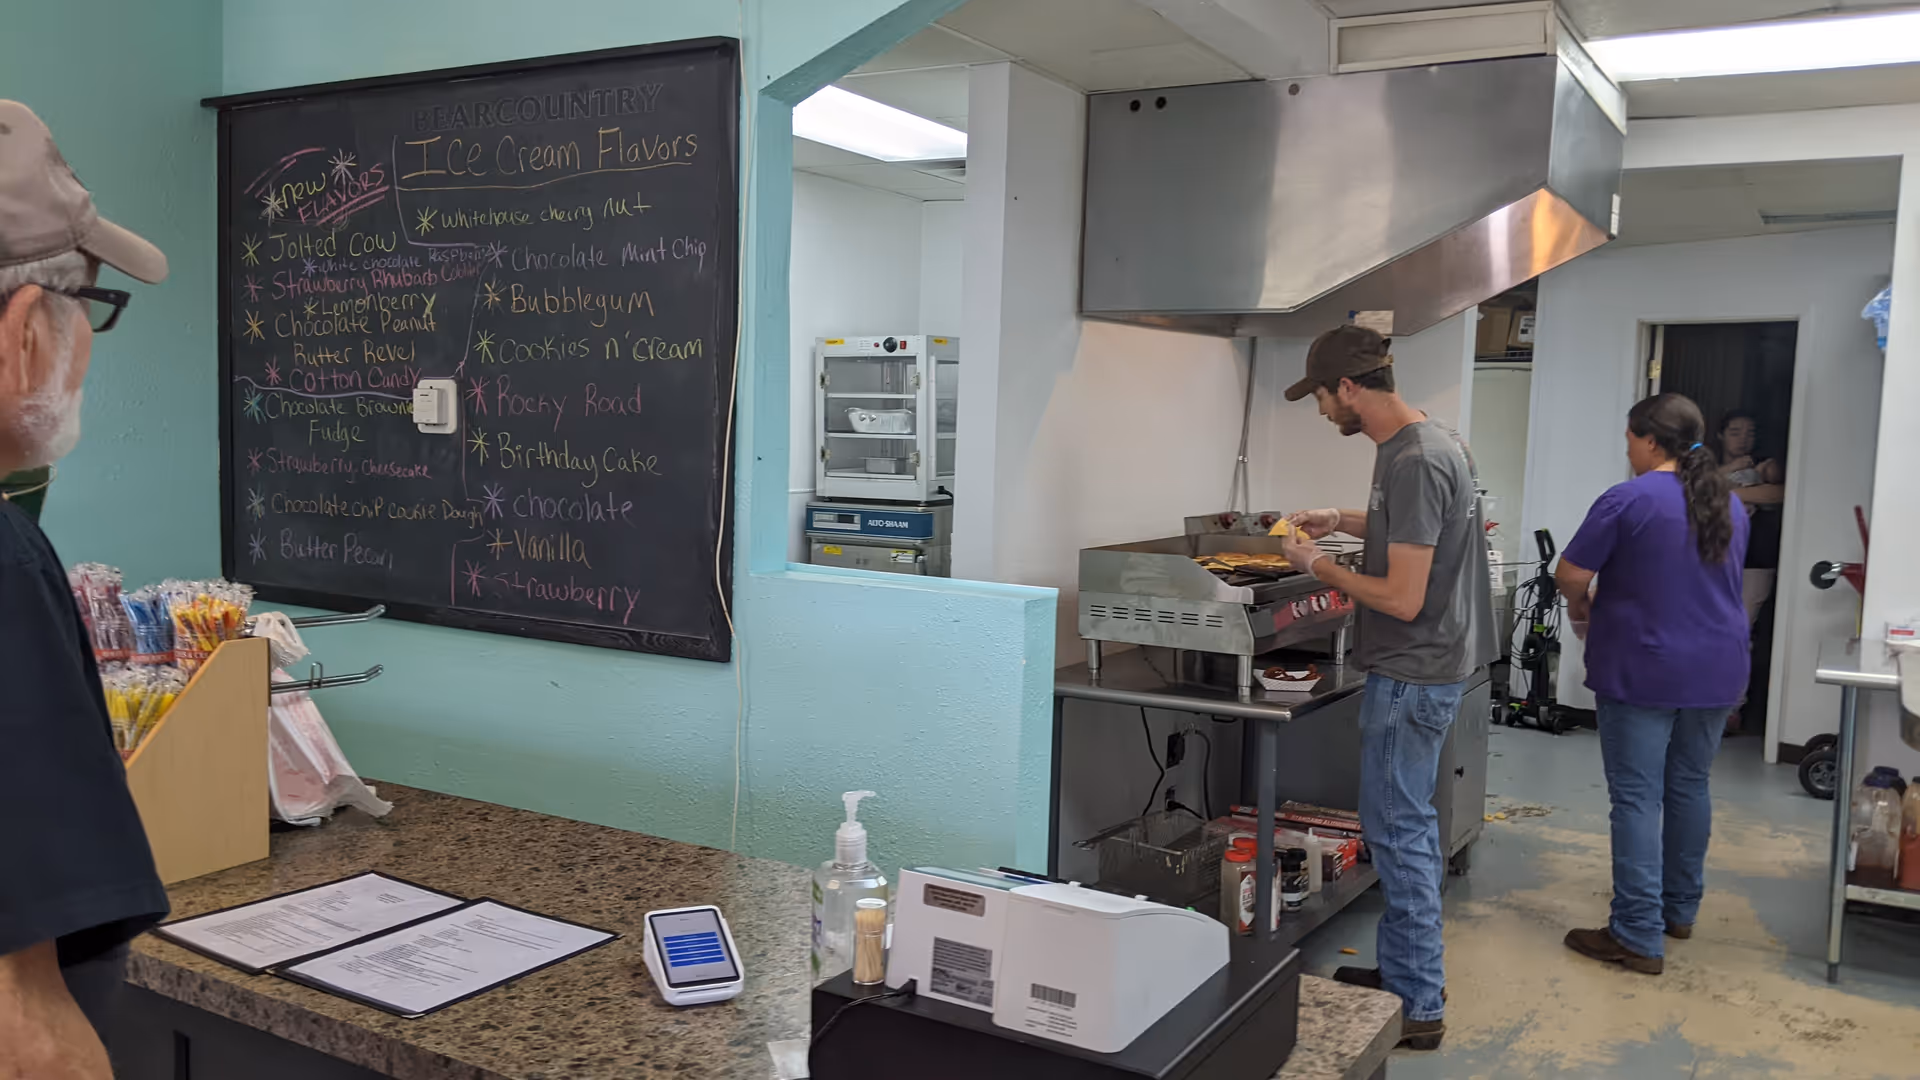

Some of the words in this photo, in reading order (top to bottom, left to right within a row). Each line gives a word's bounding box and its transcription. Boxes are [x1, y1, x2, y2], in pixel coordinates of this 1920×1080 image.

[402, 136, 485, 180] Ice
[496, 135, 581, 176] Cream
[598, 127, 698, 169] Flavors
[298, 163, 385, 224] FLAVORS
[540, 203, 594, 232] cherry
[603, 192, 653, 219] nut
[268, 228, 337, 262] Jolted
[511, 243, 610, 272] Chocolate
[622, 237, 667, 267] Mint
[671, 236, 707, 274] Chip
[271, 270, 369, 299] Strawberry
[370, 269, 438, 289] Rhubarb
[275, 311, 373, 338] Chocolate
[380, 308, 437, 335] Peanut
[510, 283, 655, 328] Bubblegum
[294, 341, 353, 366] Butter
[363, 340, 416, 365] Revel
[499, 333, 590, 364] Cookies
[289, 368, 363, 392] Cotton
[367, 366, 423, 390] Candy
[265, 393, 350, 419] Chocolate
[496, 374, 568, 432] Rocky
[585, 382, 643, 417] Road
[309, 419, 367, 452] Fudge
[266, 447, 354, 484] Strawberry
[497, 431, 599, 488] Birthday
[602, 446, 663, 475] Cake
[271, 492, 350, 517] Chocolate
[441, 498, 484, 530] Dough
[868, 519, 908, 528] ALTO-SHAAM
[280, 528, 339, 560] Butter
[343, 532, 394, 571] Pecan
[513, 528, 593, 570] Vanilla
[493, 571, 641, 626] Strawberry
